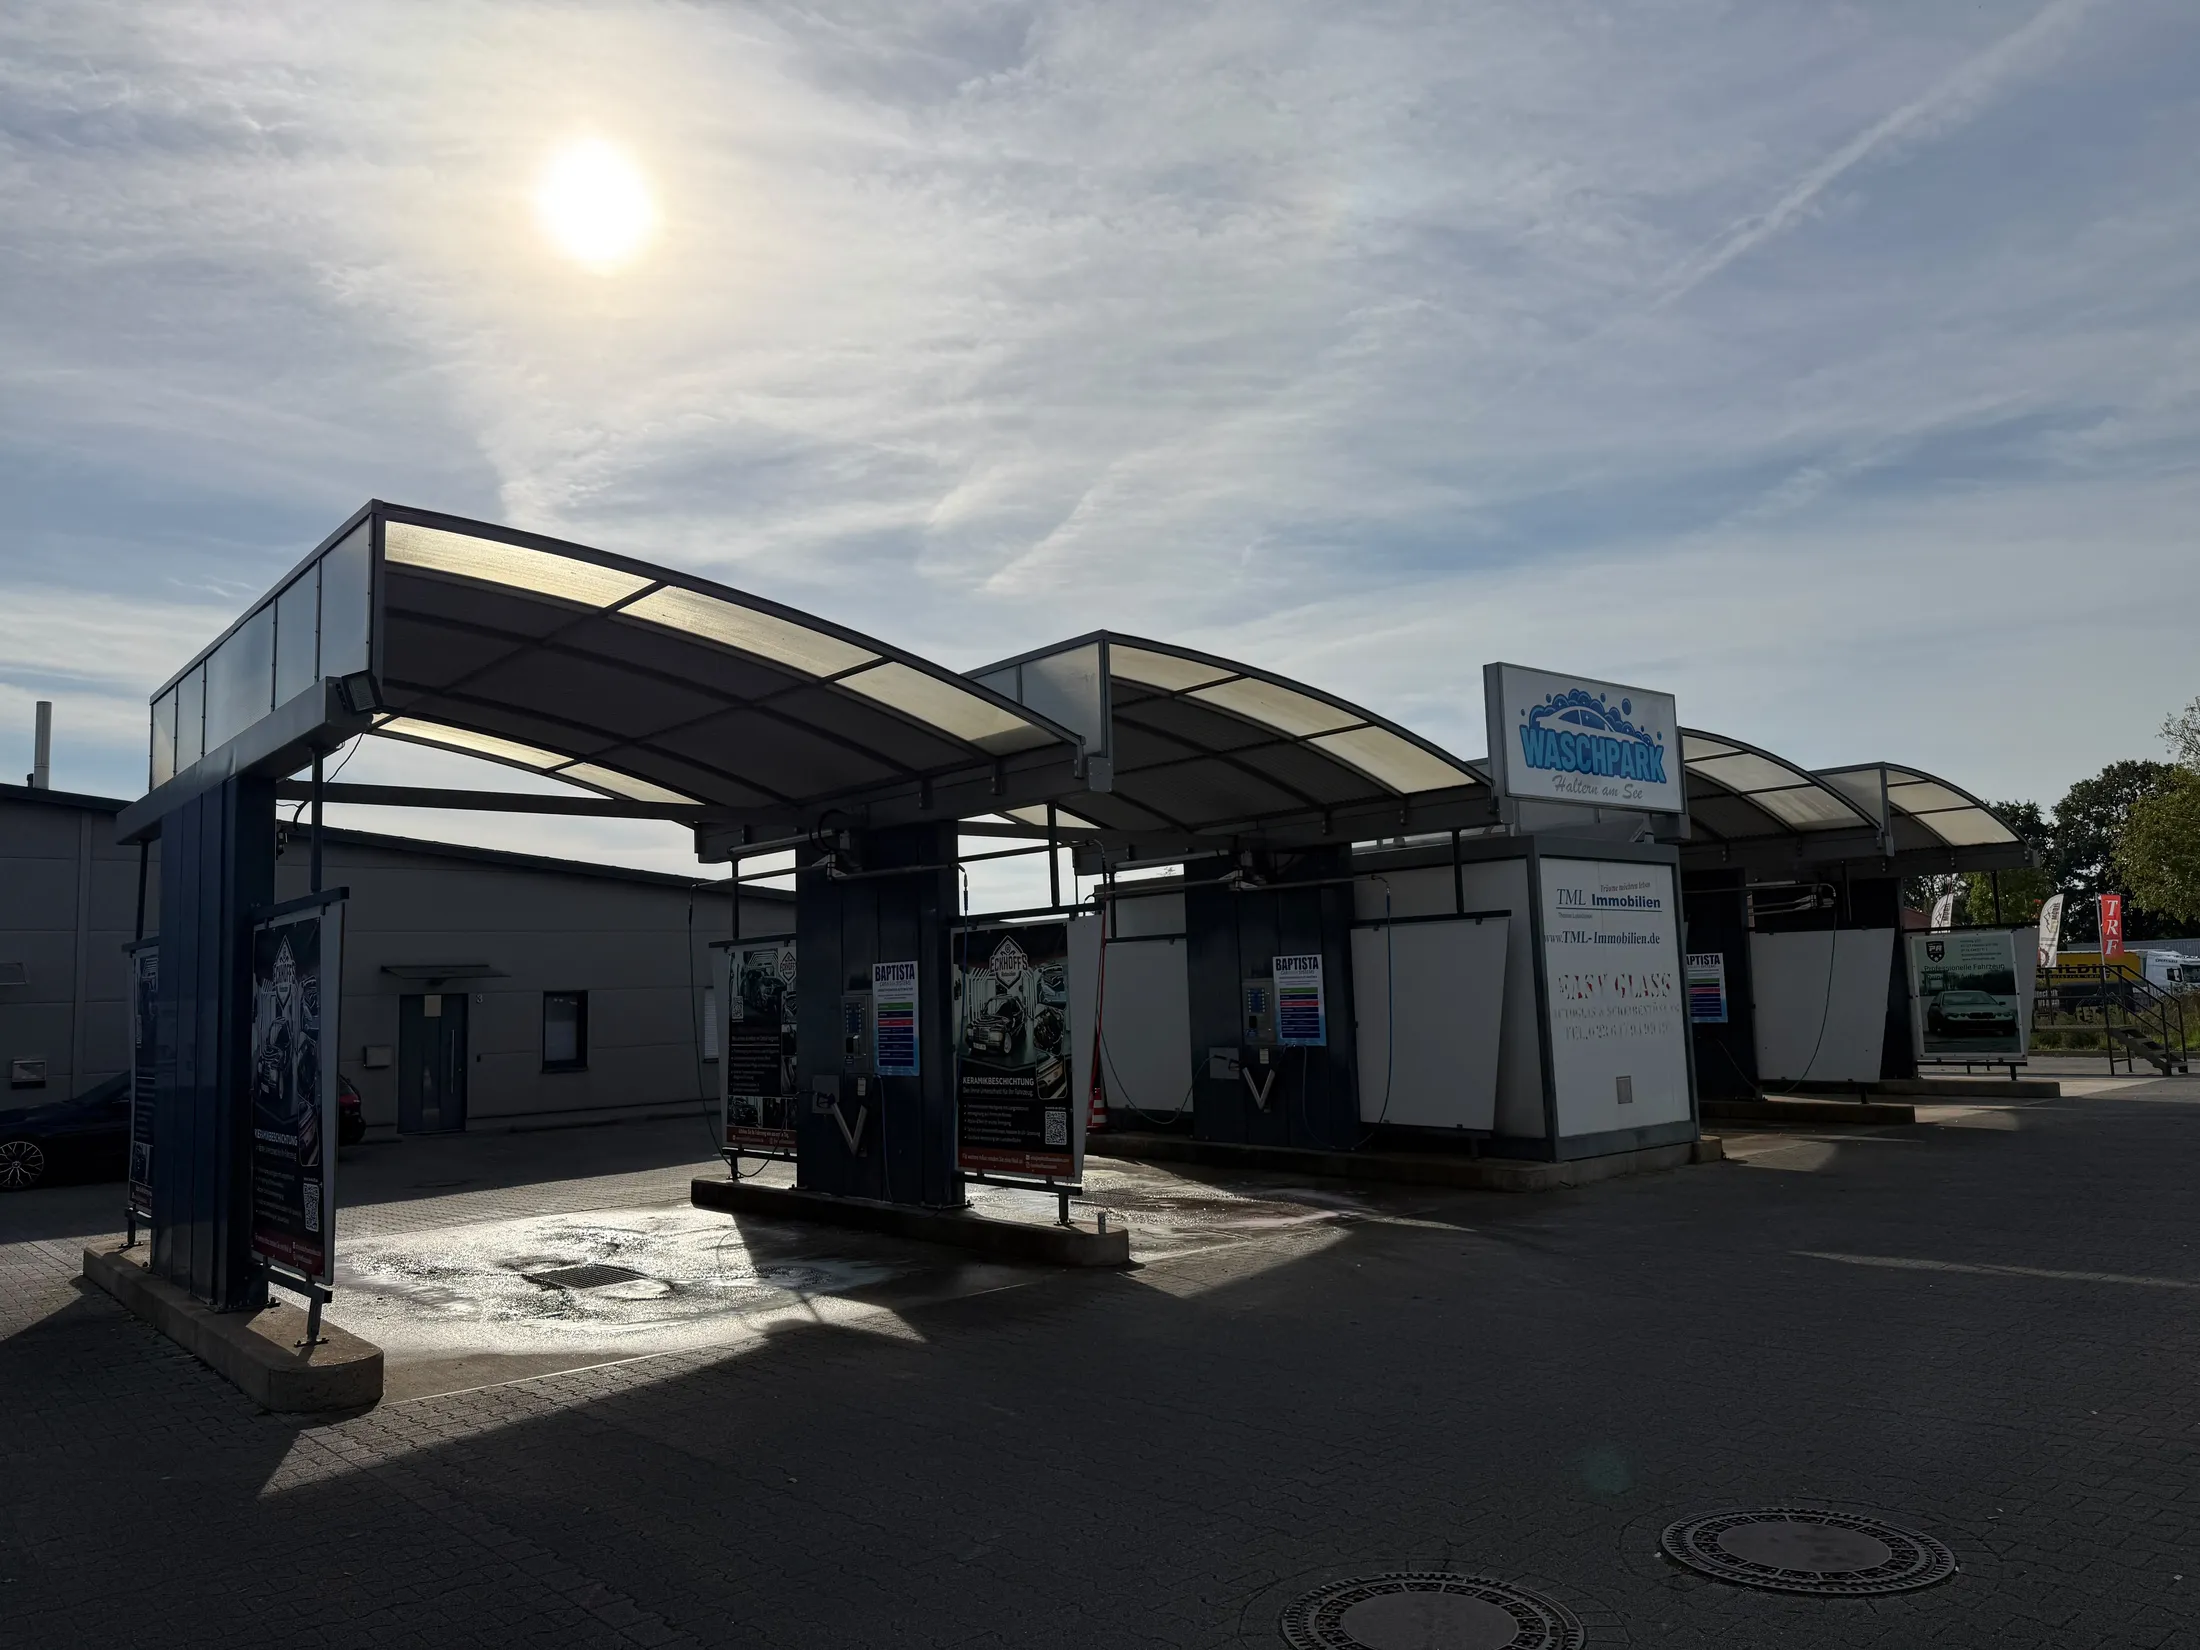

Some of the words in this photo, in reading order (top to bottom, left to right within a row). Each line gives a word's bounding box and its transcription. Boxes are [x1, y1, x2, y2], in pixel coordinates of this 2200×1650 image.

[1519, 724, 1667, 784] WASCHPARK
[1552, 774, 1599, 796] Haltern
[1602, 787, 1619, 797] am
[1622, 783, 1644, 800] See
[1557, 888, 1586, 906] TML
[1591, 893, 1661, 909] Immobilien
[2105, 900, 2119, 955] TRF
[1276, 956, 1319, 971] BAPTISTA
[1686, 954, 1721, 966] APTISTA
[875, 963, 915, 982] BAPTISTA
[962, 1076, 1035, 1086] KERAMIKBESCHICHTUNG
